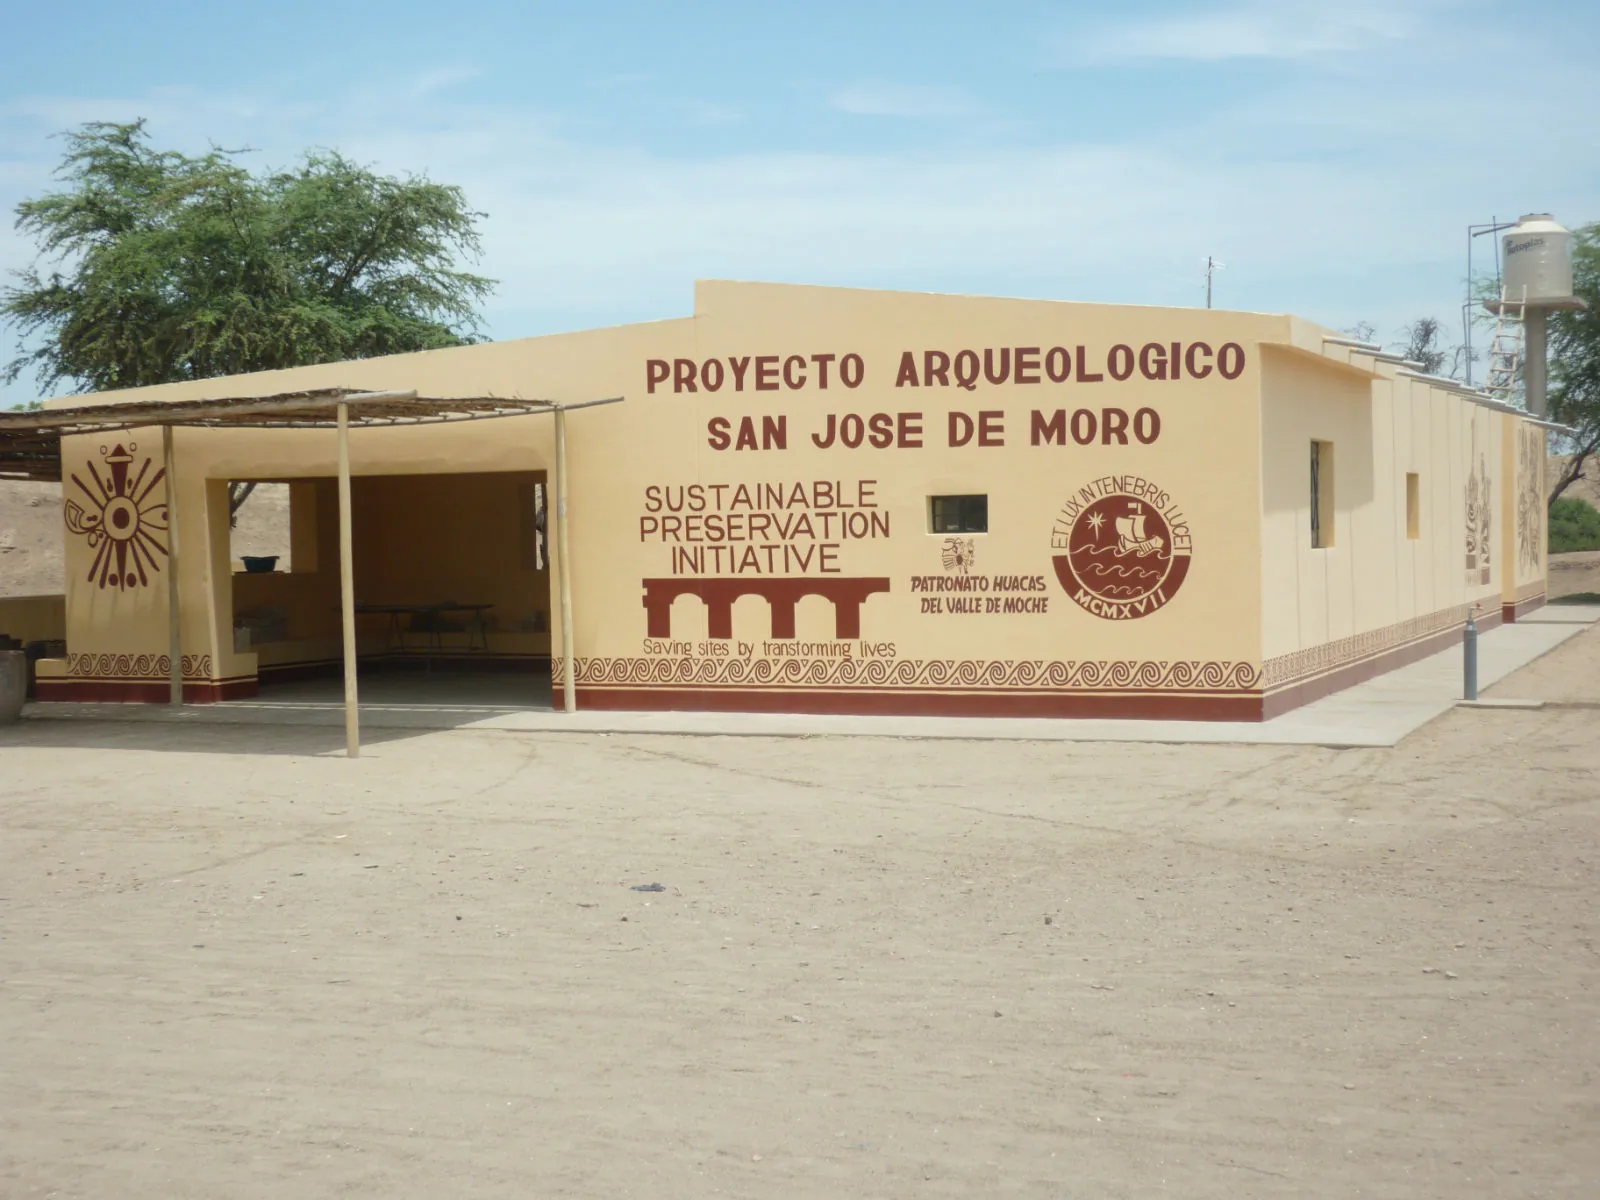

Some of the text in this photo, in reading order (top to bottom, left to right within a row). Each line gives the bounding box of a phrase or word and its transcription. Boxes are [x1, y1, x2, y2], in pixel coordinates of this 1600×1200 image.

[647, 342, 1245, 393] PROYECTO ARQUEOLOGICO
[708, 407, 1160, 451] SAN JOSE DE MORO
[645, 480, 877, 512] SUSTAINABLE
[1091, 475, 1170, 510] TENEBRIS
[1056, 495, 1084, 526] LUX
[640, 511, 889, 543] PRESERVATION
[1051, 526, 1069, 549] ET
[1164, 505, 1192, 554] LUCET
[672, 544, 840, 574] INITIATIVE
[911, 576, 1046, 592] PATRONATO HUACAS
[921, 597, 1048, 613] DEL VALLE DE MOCHE
[1073, 588, 1166, 619] MCMXVII
[643, 639, 692, 659] Saving
[698, 640, 729, 656] sites
[738, 641, 754, 660] by
[860, 640, 896, 657] lives
